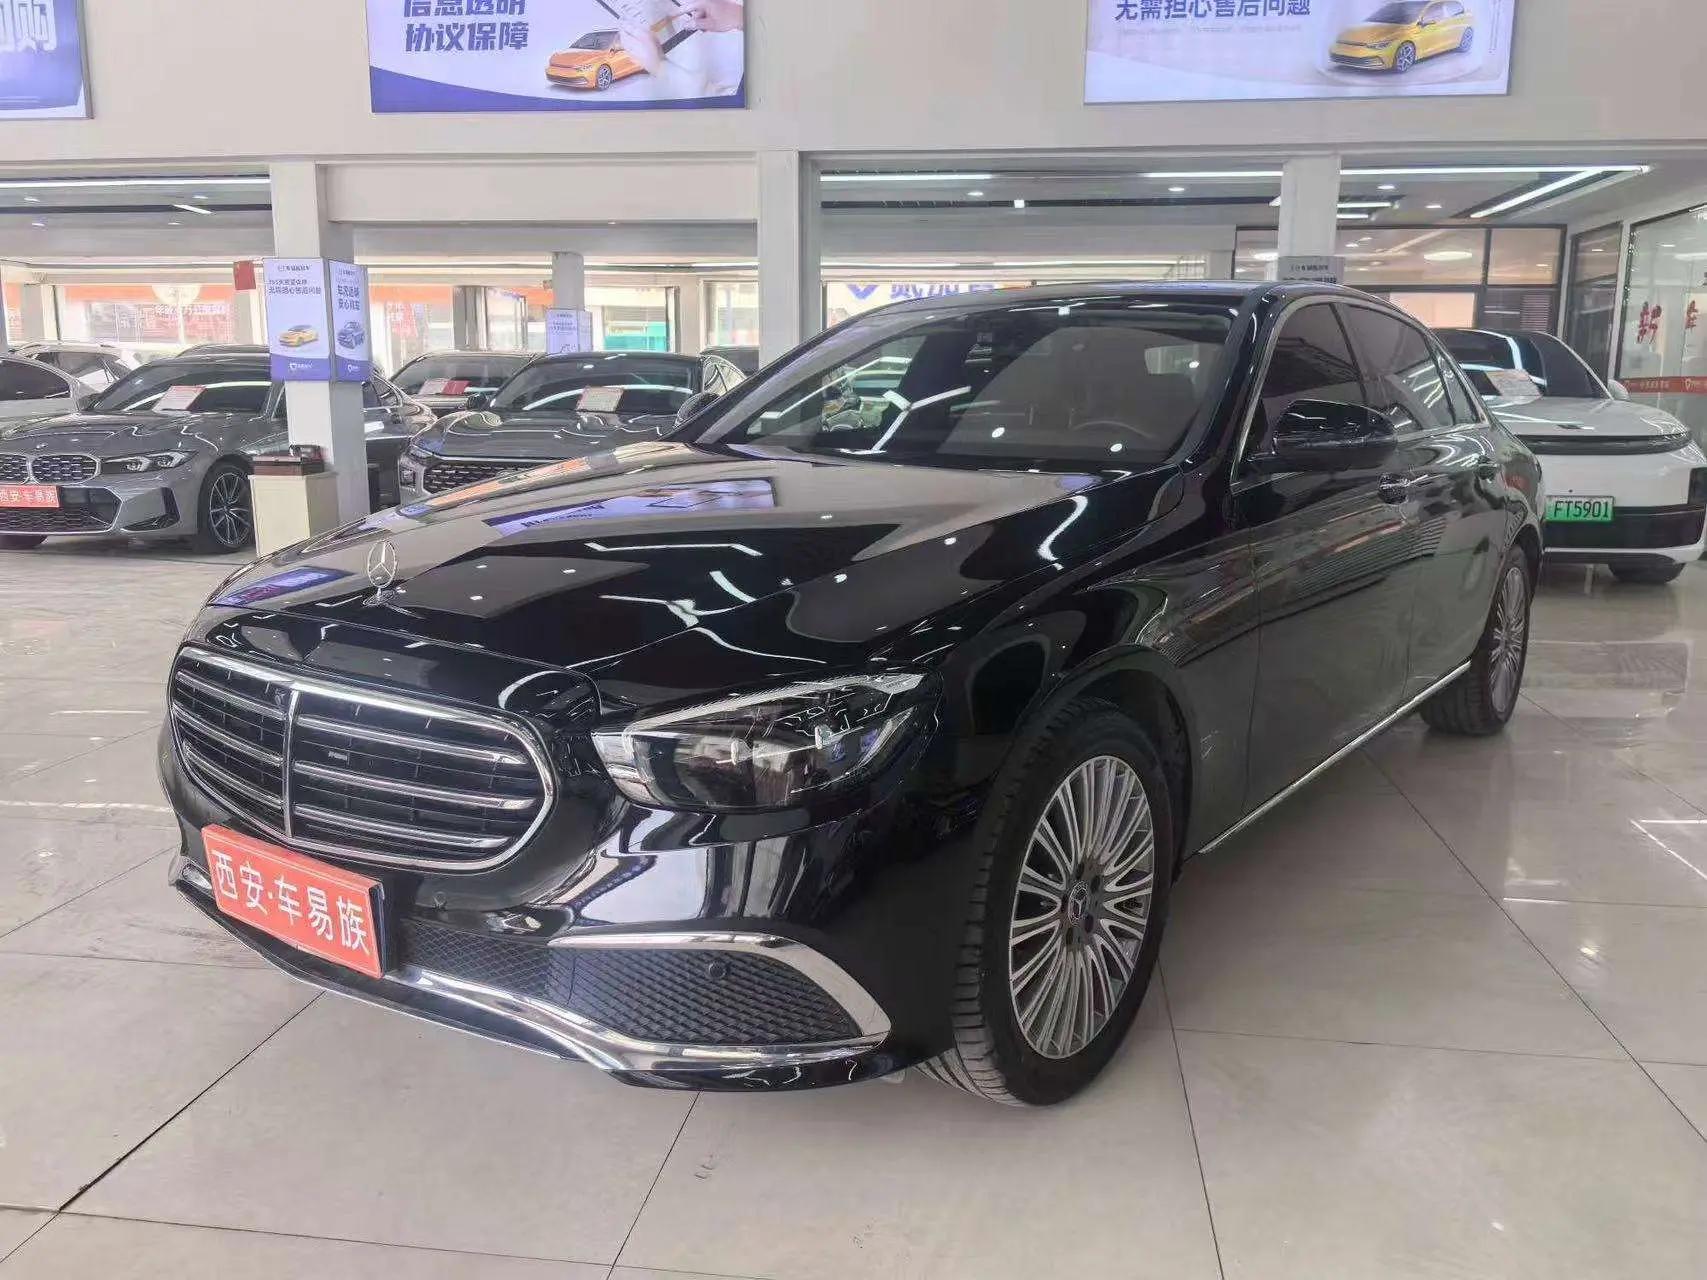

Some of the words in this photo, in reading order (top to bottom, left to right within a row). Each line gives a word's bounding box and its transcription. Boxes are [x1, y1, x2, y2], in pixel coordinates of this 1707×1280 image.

[1115, 0, 1310, 21] 无需担心售后问题
[405, 22, 529, 52] 协议保障
[1554, 500, 1609, 518] FT5901
[211, 849, 371, 956] 西安·车易族
